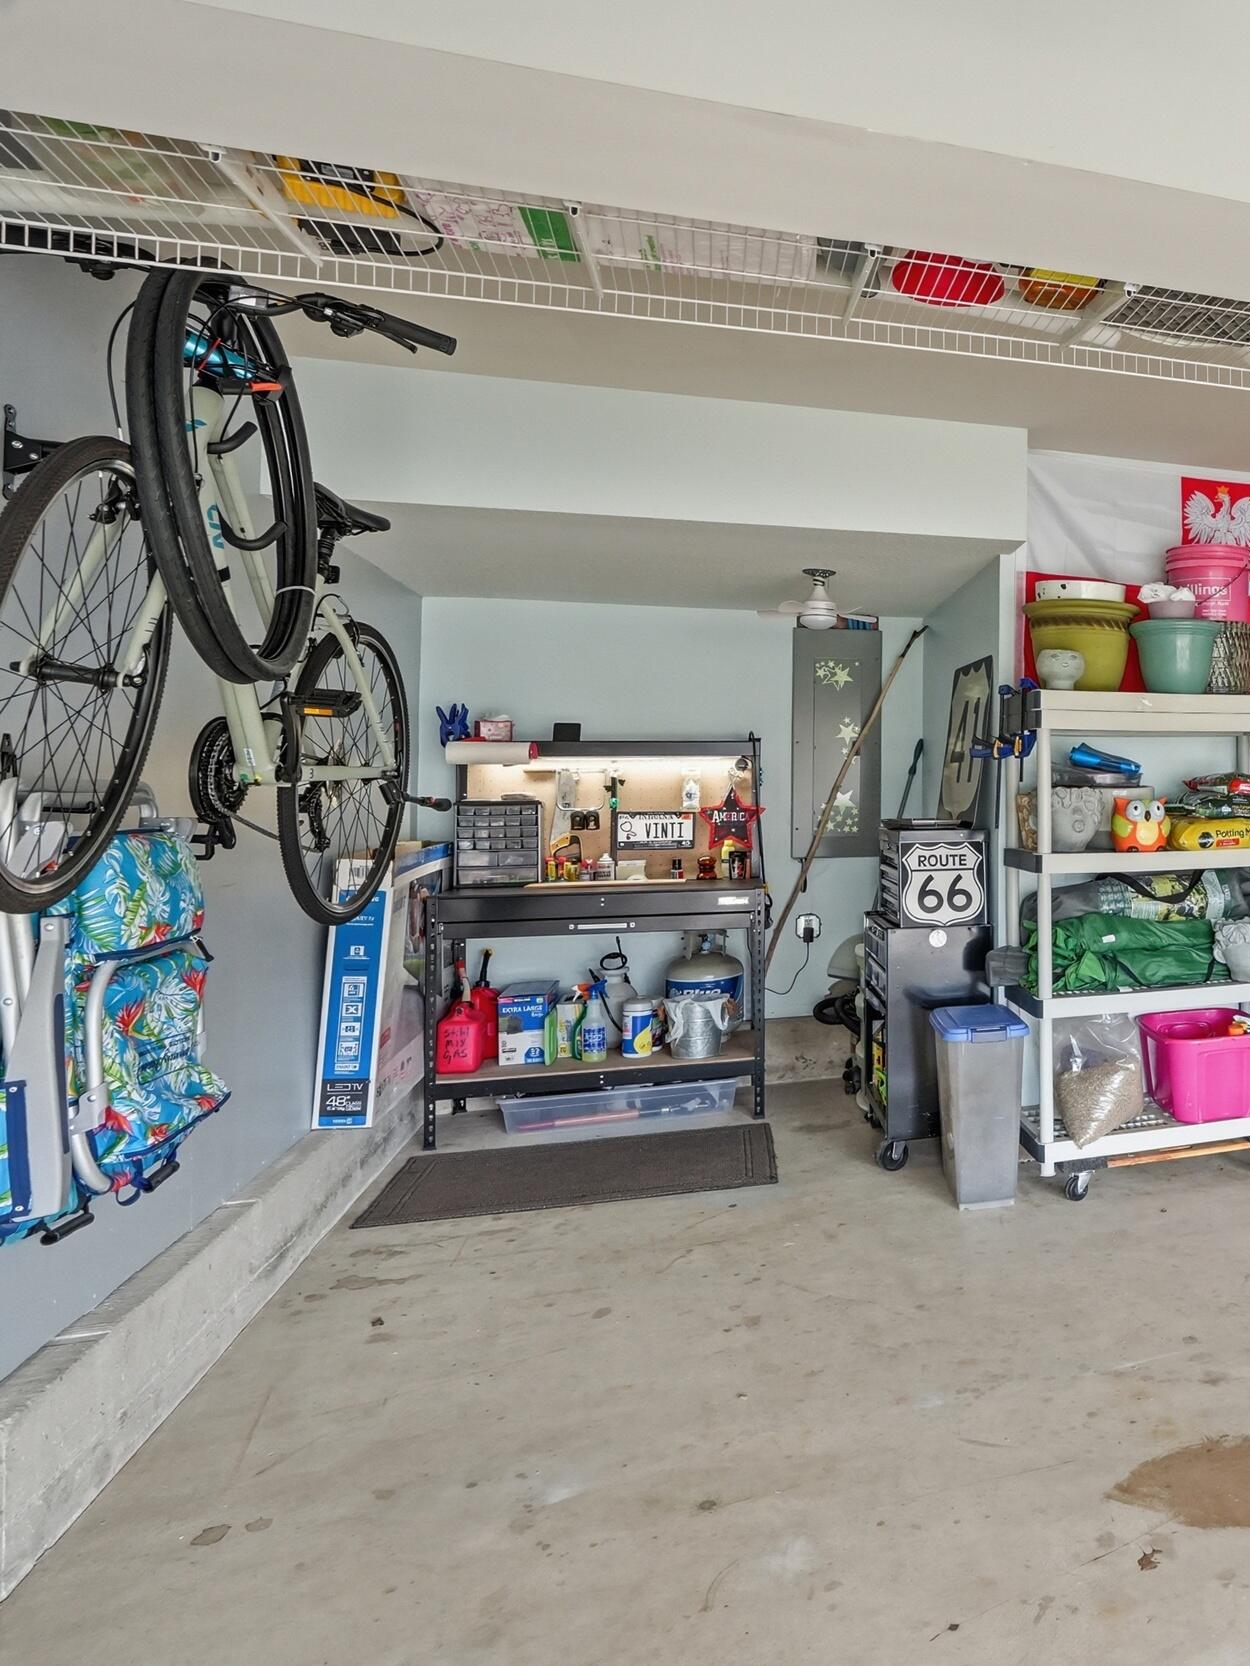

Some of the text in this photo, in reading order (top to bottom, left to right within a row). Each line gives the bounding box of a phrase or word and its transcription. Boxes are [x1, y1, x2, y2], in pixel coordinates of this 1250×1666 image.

[645, 822, 684, 839] VINTI
[1215, 828, 1245, 839] Potting
[917, 853, 967, 867] ROUTE
[917, 873, 973, 914] 66
[523, 1004, 543, 1012] LARGE
[327, 1083, 351, 1091] LED
